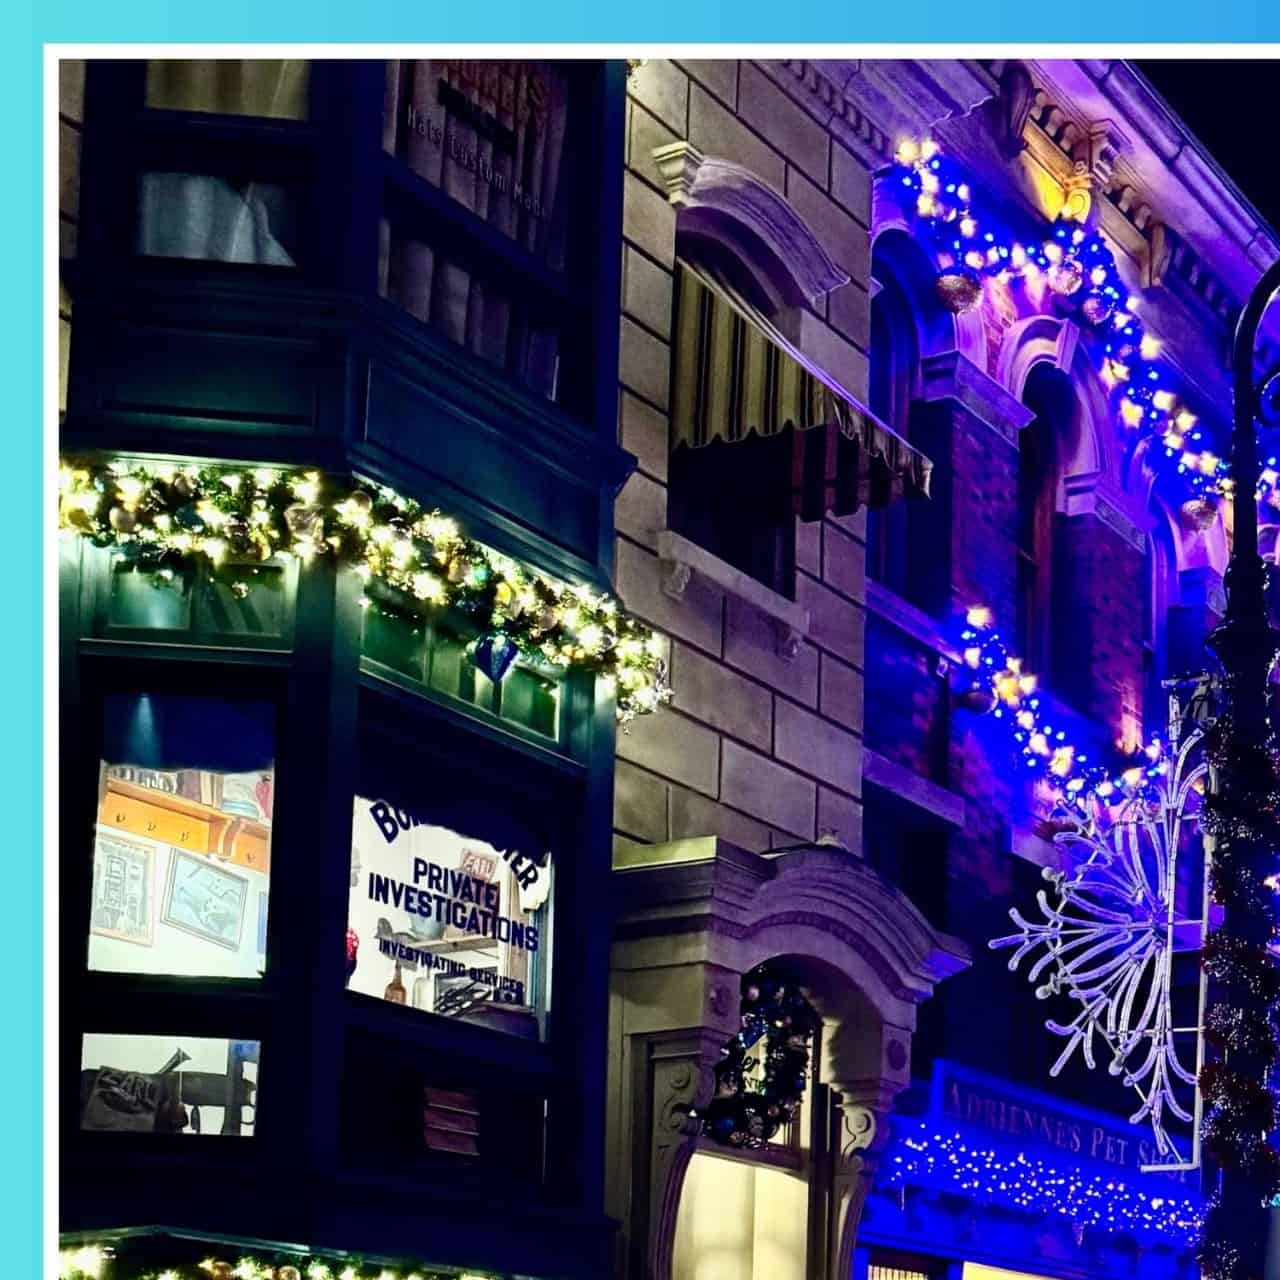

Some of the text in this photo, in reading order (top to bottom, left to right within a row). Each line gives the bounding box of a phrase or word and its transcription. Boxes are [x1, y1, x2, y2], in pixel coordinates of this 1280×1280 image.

[369, 872, 539, 951] INVESTIGATIONS
[414, 857, 500, 912] PRIVATE
[379, 938, 524, 994] INVESTIGATING SERVICES
[1091, 1128, 1128, 1164] PET
